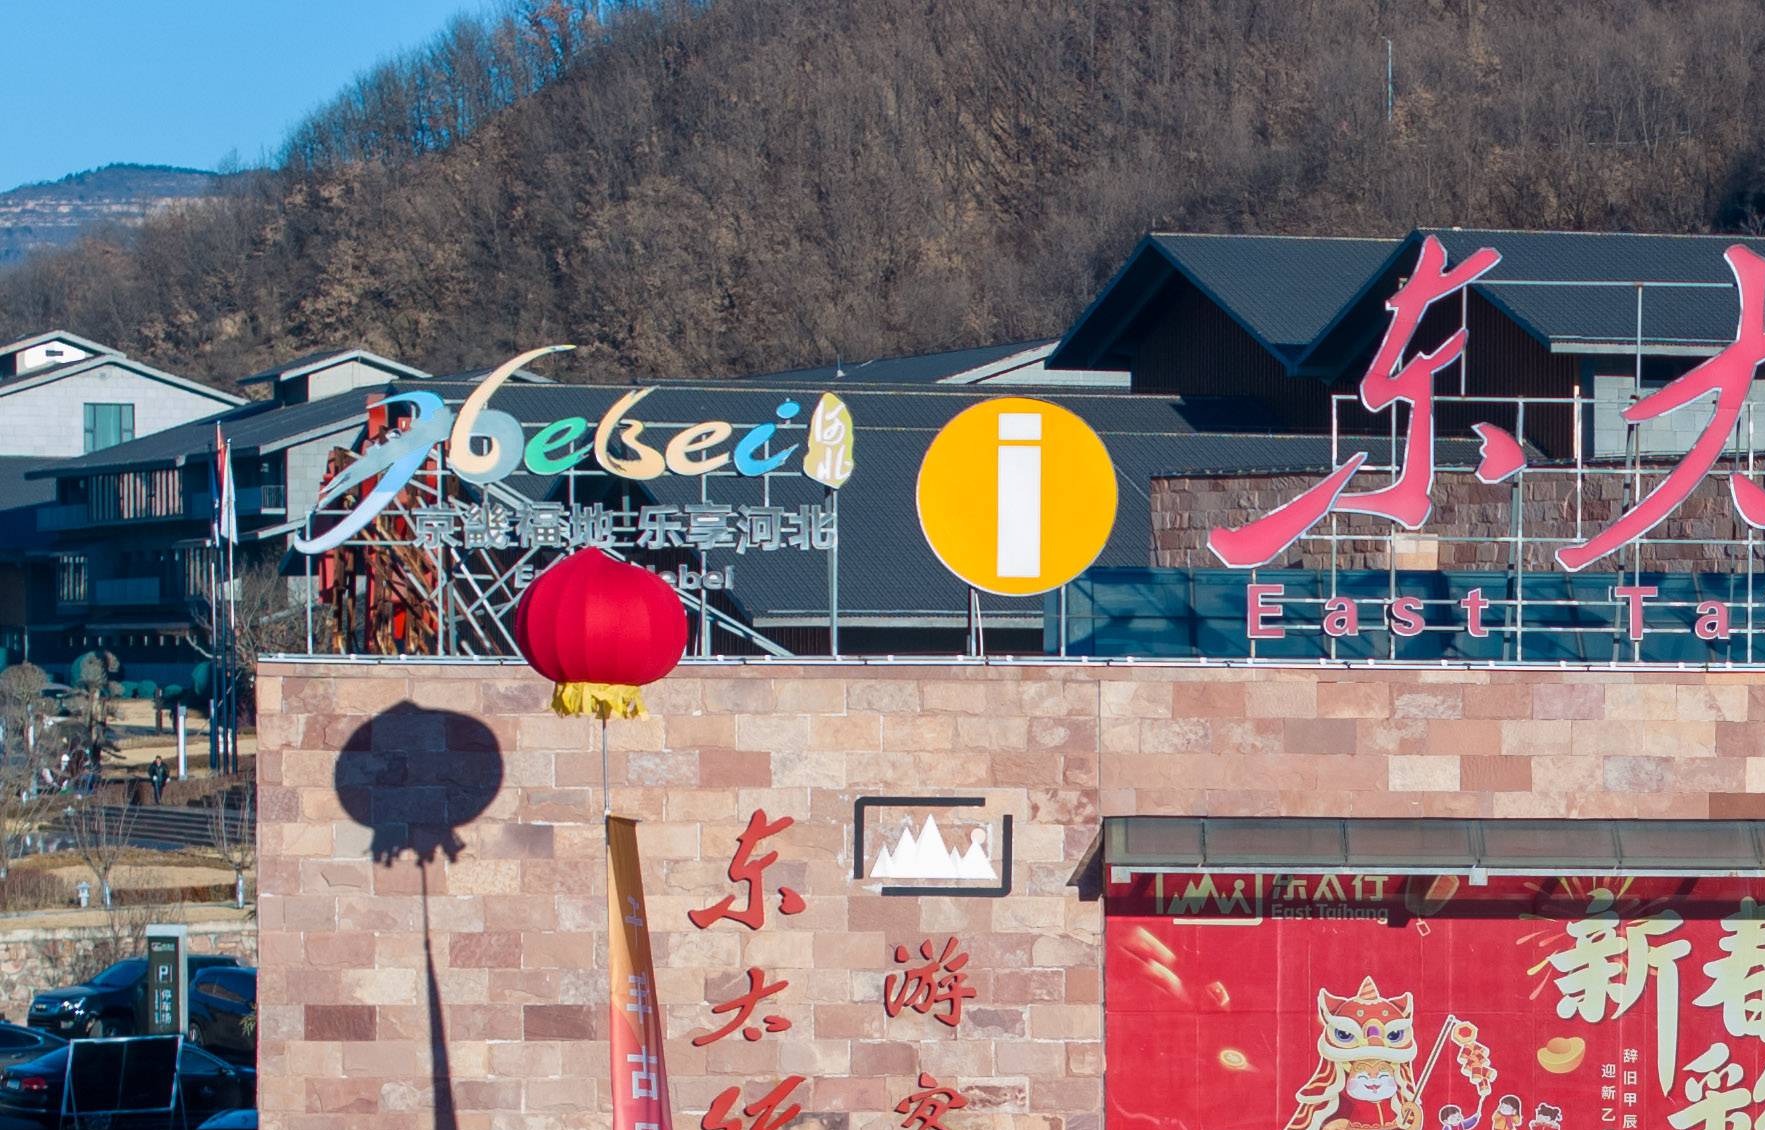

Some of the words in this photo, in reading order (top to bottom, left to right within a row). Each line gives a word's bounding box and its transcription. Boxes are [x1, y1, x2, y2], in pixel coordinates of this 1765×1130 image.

[412, 502, 616, 551] 京畿福地
[637, 501, 838, 555] 乐享河北
[1245, 583, 1491, 641] East
[1271, 903, 1312, 919] East
[1315, 902, 1389, 924] Taihang
